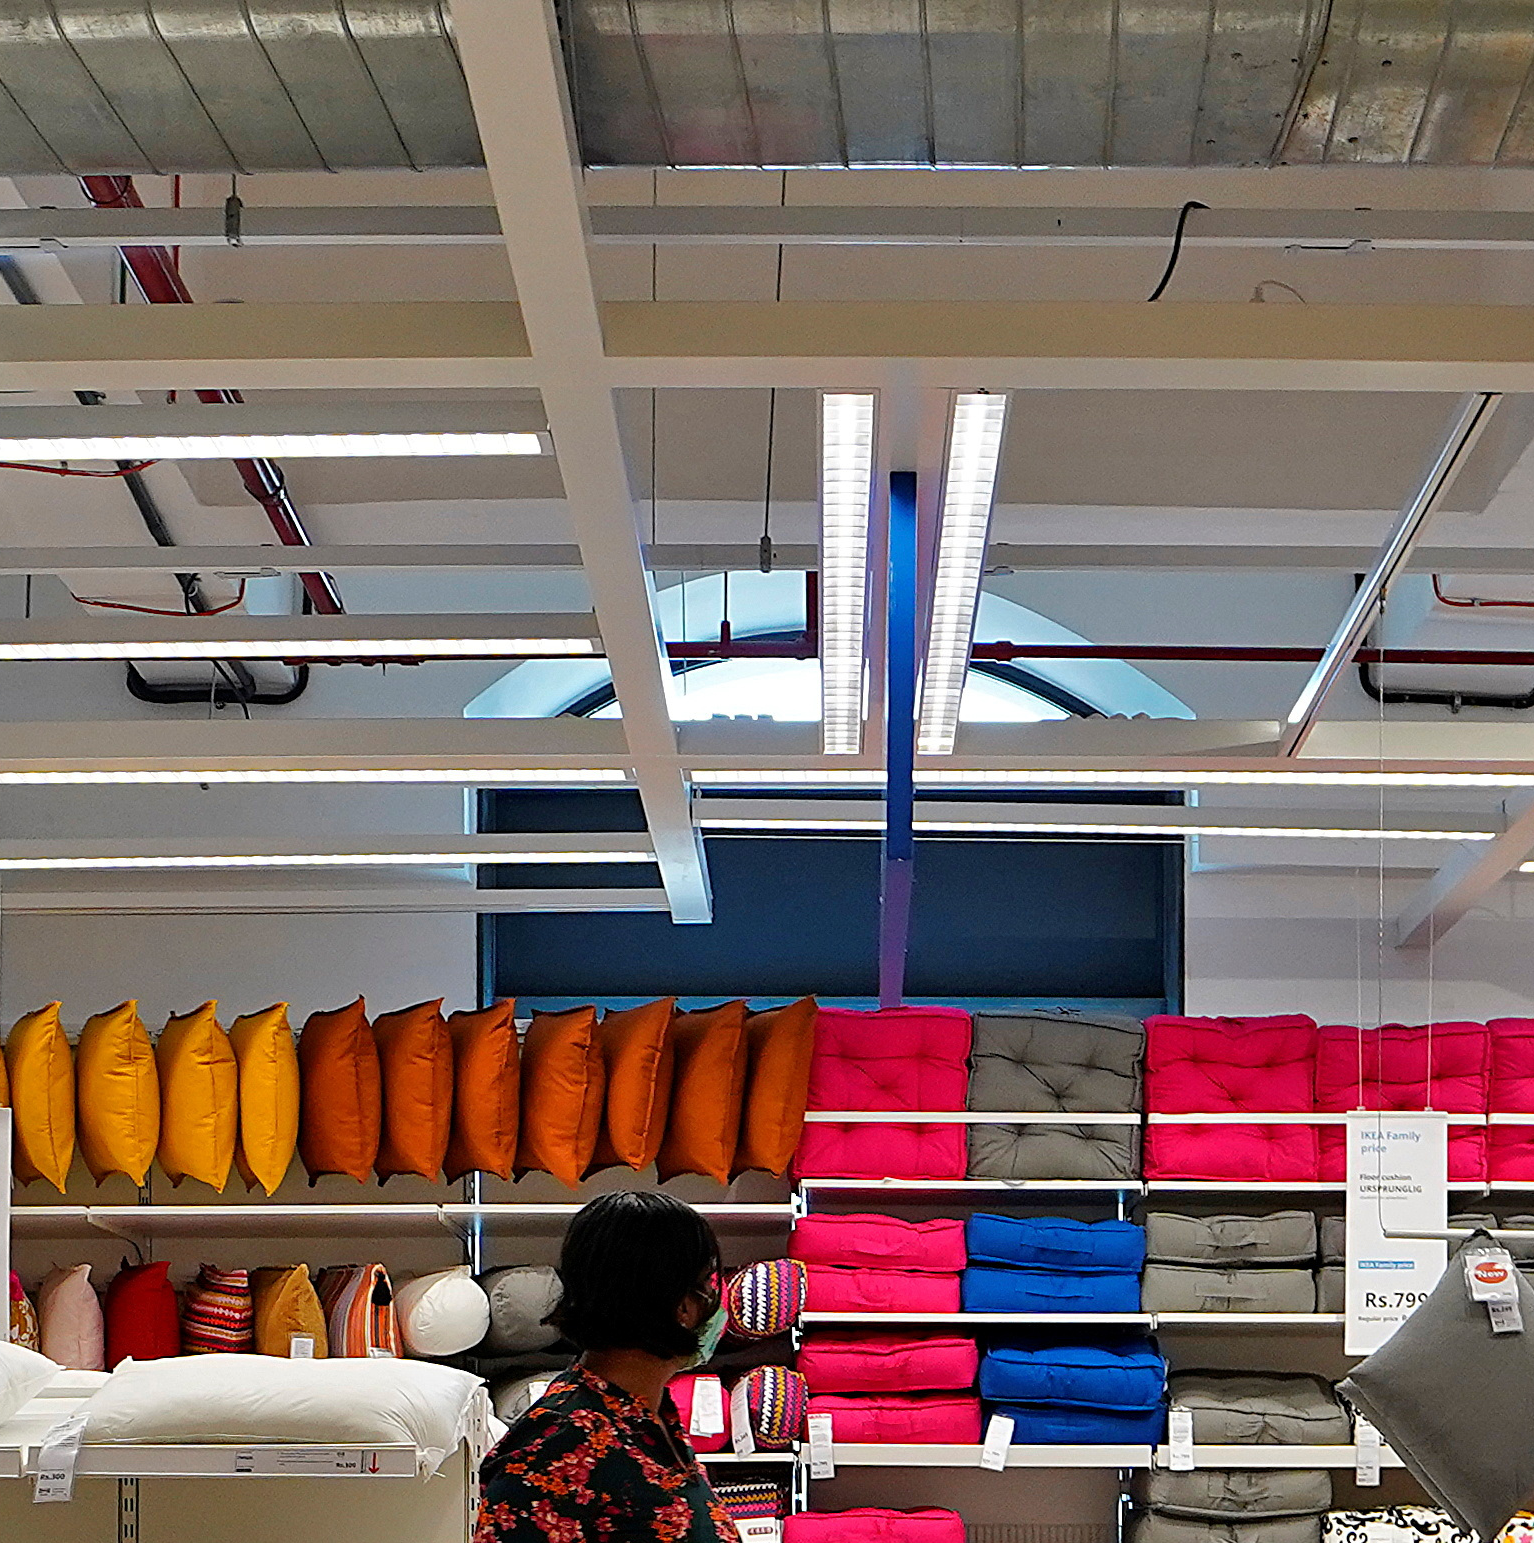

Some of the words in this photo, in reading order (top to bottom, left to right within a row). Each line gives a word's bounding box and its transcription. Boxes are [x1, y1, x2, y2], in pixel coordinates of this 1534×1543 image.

[1360, 1131, 1384, 1140] IKEA
[1386, 1131, 1421, 1142] Family
[1361, 1144, 1387, 1155] price
[1477, 1270, 1504, 1279] New
